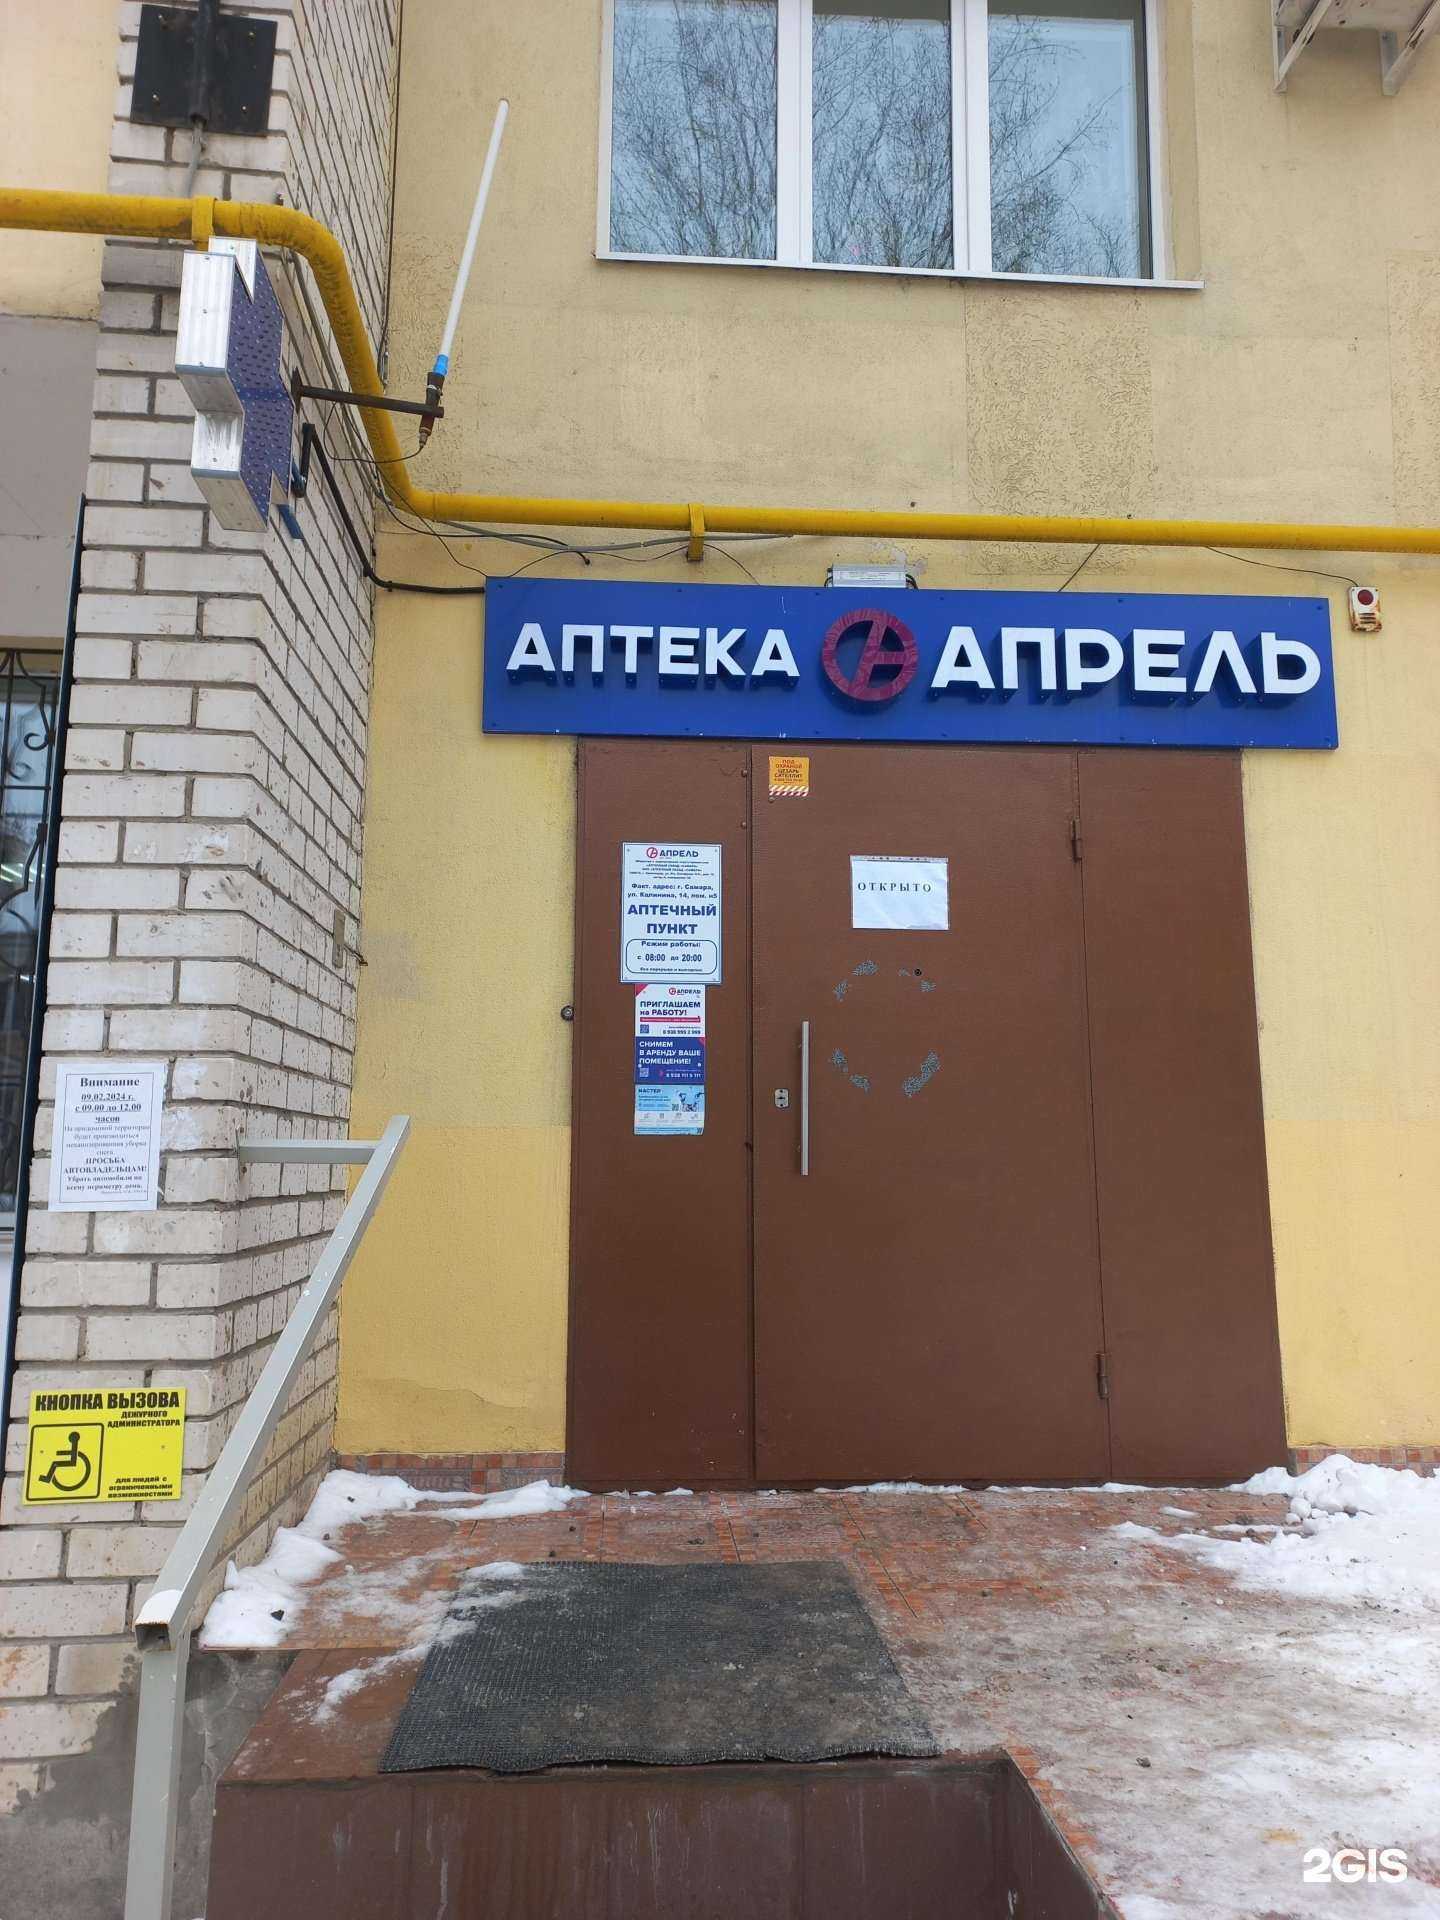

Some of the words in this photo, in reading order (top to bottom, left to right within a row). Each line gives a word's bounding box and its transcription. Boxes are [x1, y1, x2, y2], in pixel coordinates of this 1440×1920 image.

[506, 621, 801, 678] АПТЕКА
[931, 626, 1320, 696] АПРЕЛЬ
[659, 849, 699, 857] АПРЕЛЬ
[857, 881, 932, 893] ОТКРЫТО
[627, 903, 717, 916] АПТЕЧНЫЙ
[646, 923, 698, 934] ПУНКТ
[645, 953, 666, 962] 08:00
[681, 954, 702, 962] 20:00
[640, 1000, 701, 1008] ПРИГЛАШАЕМ
[646, 1049, 677, 1057] АРЕНДУ
[678, 1049, 701, 1057] ВАШЕ
[639, 1057, 691, 1065] ПОМЕЩЕНИЕ!
[80, 1076, 140, 1088] Внимание
[81, 1092, 126, 1101] 09.02.2024
[81, 1104, 105, 1112] 09.00
[119, 1103, 142, 1112] 12.00
[95, 1115, 120, 1123] часов
[85, 1157, 126, 1165] ПРОСЬБА
[35, 1393, 104, 1411] КНОПКА
[106, 1391, 180, 1410] ВЫЗОВА
[120, 1410, 168, 1419] ДЕЖУРНОГО
[107, 1419, 181, 1429] АДМИНИСТРАТОРА
[108, 1483, 173, 1492] ограниченными
[107, 1491, 173, 1499] возможностями
